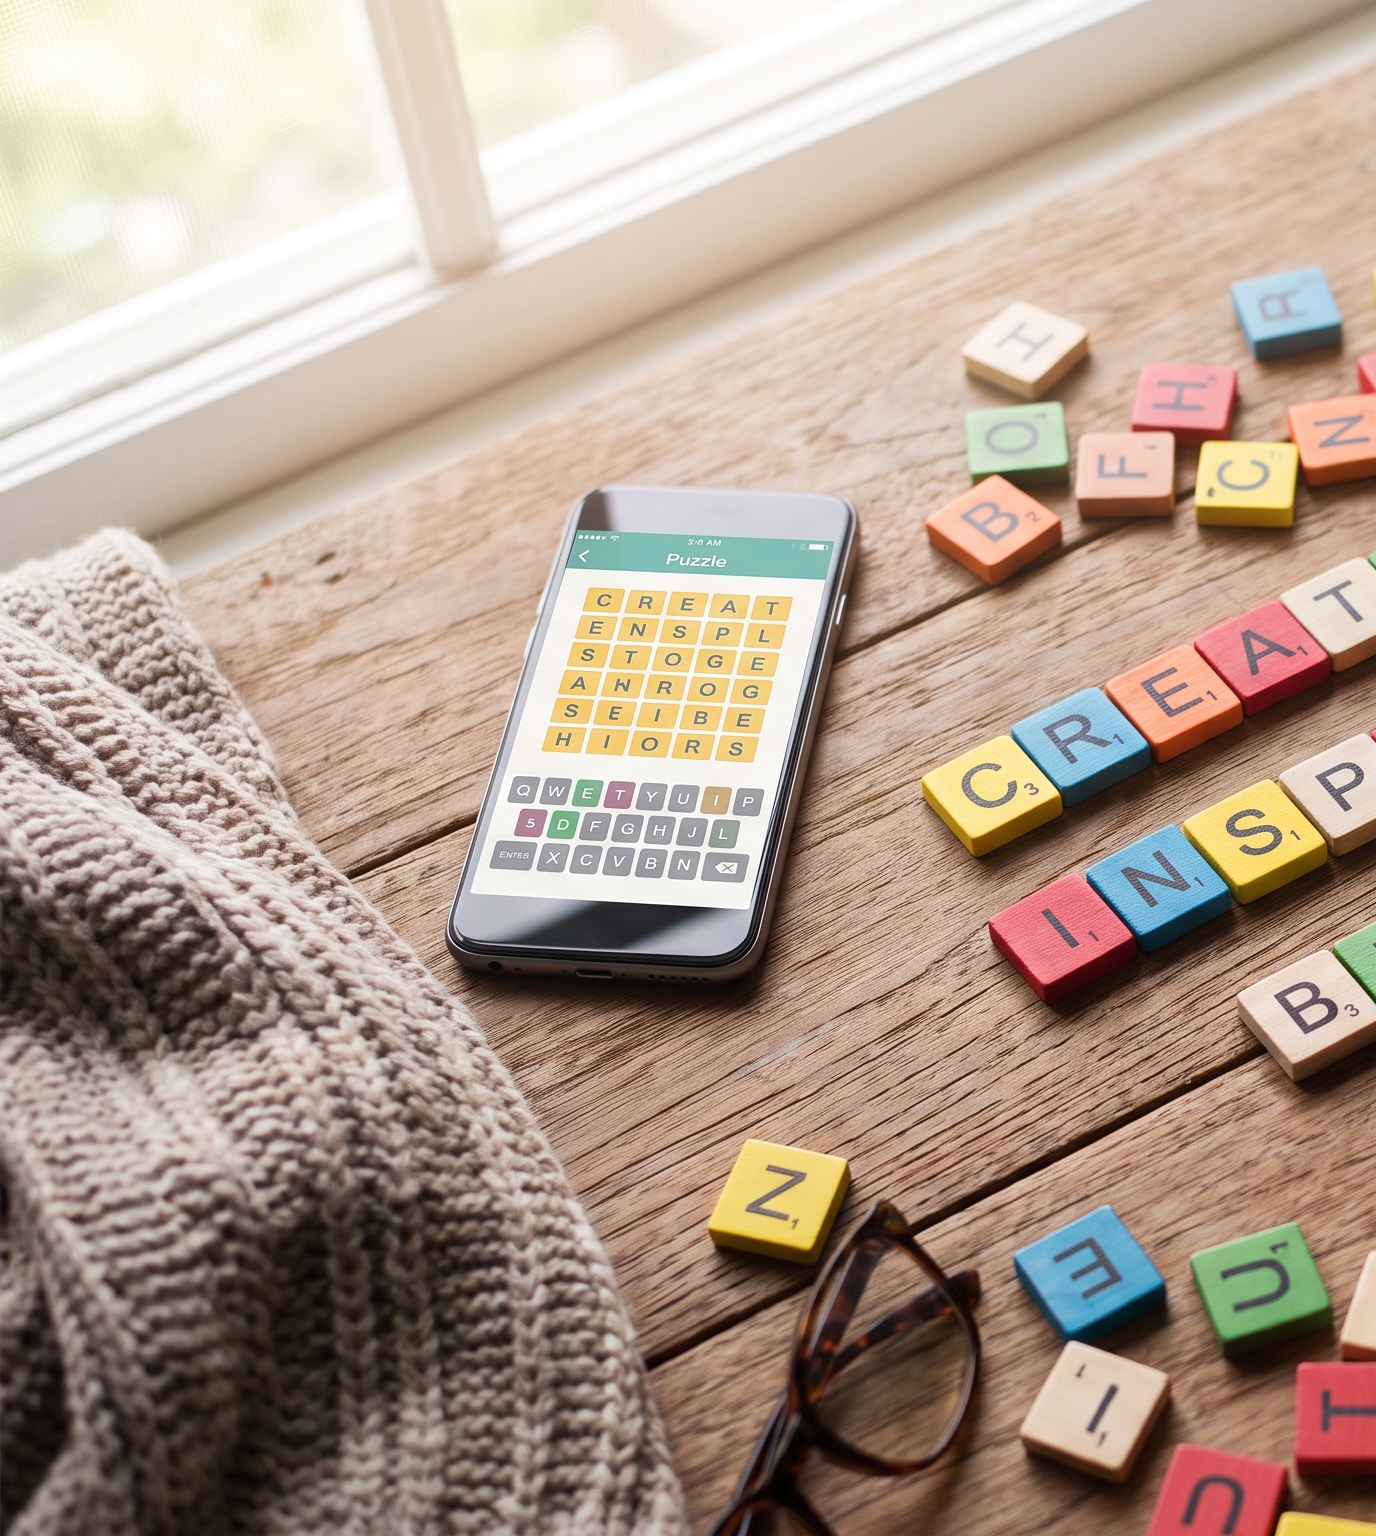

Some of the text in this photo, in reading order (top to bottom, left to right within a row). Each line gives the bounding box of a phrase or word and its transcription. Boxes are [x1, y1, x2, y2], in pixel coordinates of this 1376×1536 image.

[1259, 288, 1307, 322] R
[995, 322, 1055, 361] H
[1153, 381, 1207, 411] H
[984, 421, 1039, 455] O
[1097, 454, 1148, 478] F
[1217, 460, 1270, 491] C
[960, 501, 1041, 543] B 2
[706, 539, 722, 547] AM
[666, 552, 728, 568] Puzzle
[517, 785, 531, 797] Q
[548, 786, 566, 797] W
[582, 788, 594, 799] E
[615, 790, 627, 801] T
[646, 791, 658, 803] Y
[677, 793, 690, 805] U
[742, 797, 754, 808] P
[1023, 782, 1040, 797] 3
[557, 819, 570, 831] D
[590, 821, 602, 832] F
[621, 823, 635, 835] G
[653, 825, 666, 836] H
[687, 827, 697, 838] J
[719, 828, 728, 840] L
[546, 852, 560, 865] X
[580, 854, 593, 866] C
[613, 856, 626, 867] V
[645, 858, 657, 870] B
[677, 859, 691, 871] N
[1343, 1003, 1360, 1018] 3
[1053, 1236, 1124, 1300] E
[1221, 1258, 1290, 1314] U
